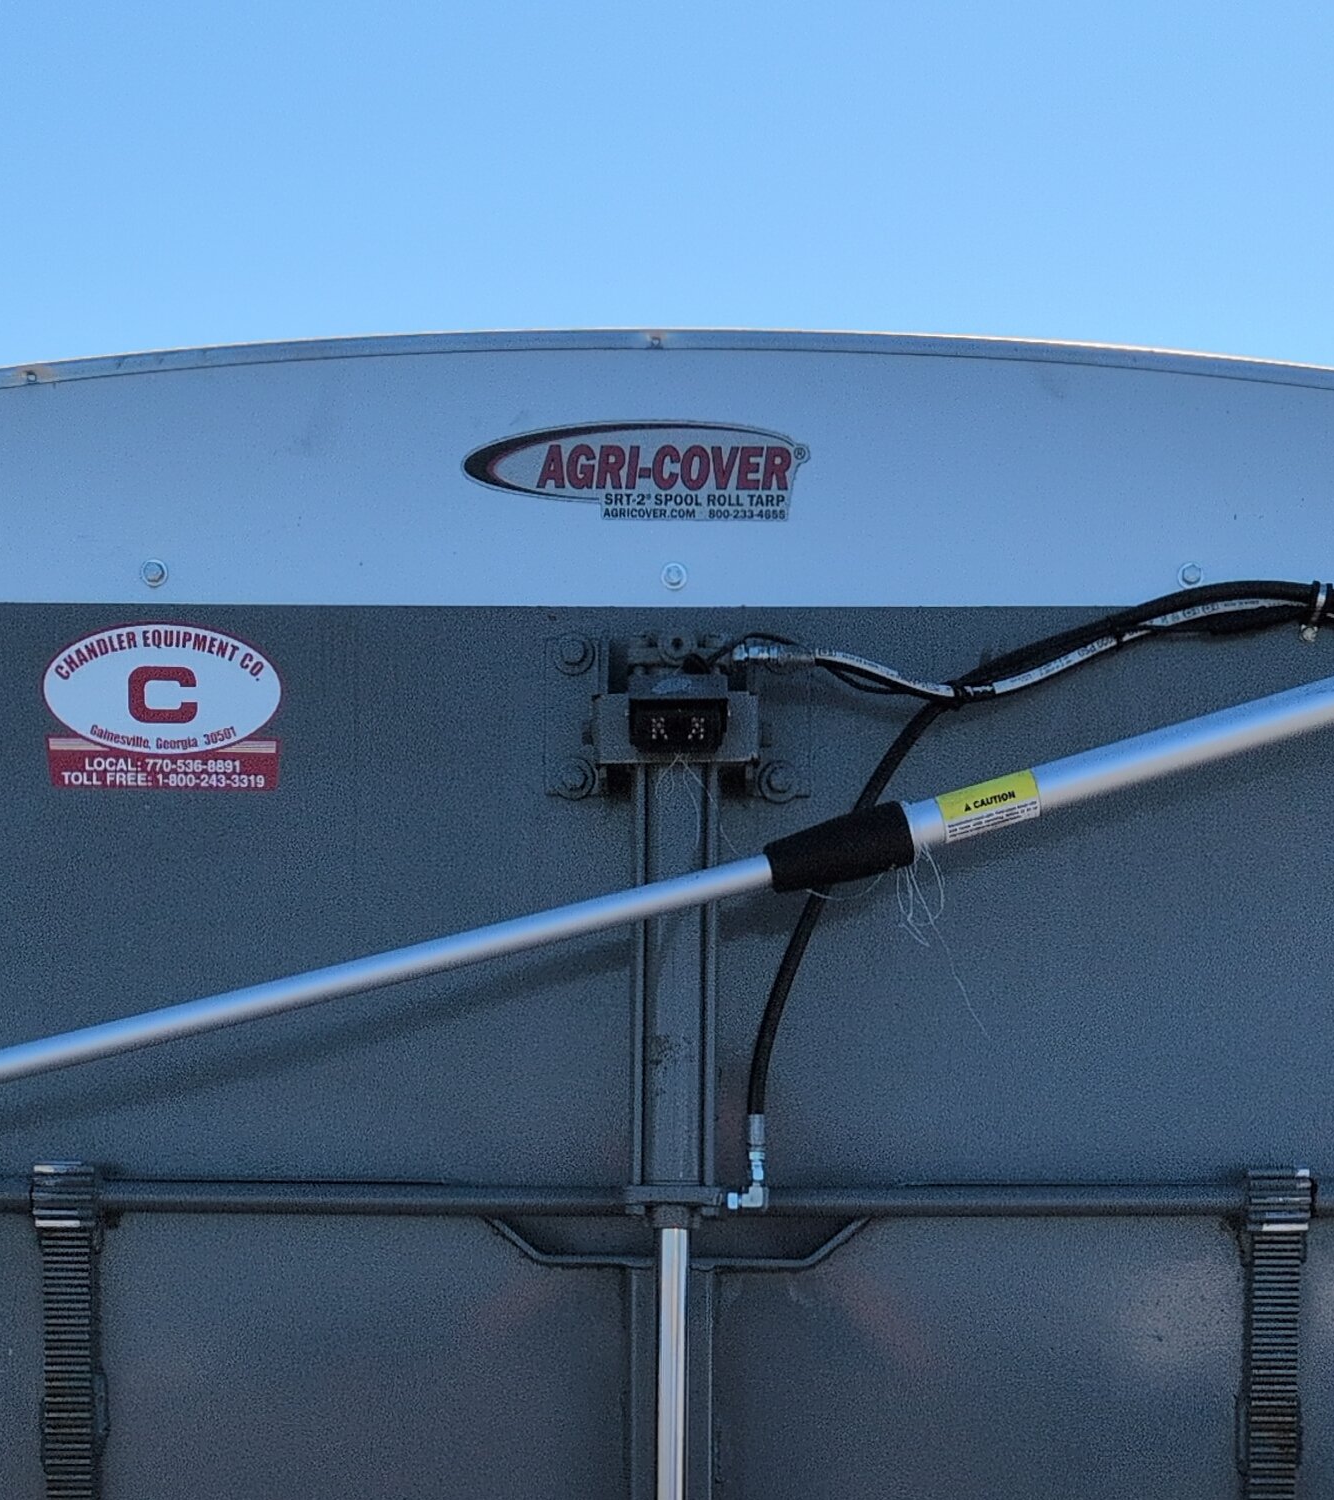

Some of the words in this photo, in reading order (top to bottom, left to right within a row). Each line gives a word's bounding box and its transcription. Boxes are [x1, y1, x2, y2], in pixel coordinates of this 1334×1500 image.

[654, 493, 702, 506] SPOOL
[707, 494, 744, 507] ROLL
[747, 494, 785, 507] TARP
[603, 508, 696, 519] AGRICOVER.COM
[54, 631, 138, 680] CHANDLER
[142, 629, 240, 662] EQUIPMENT
[239, 652, 265, 682] CO.
[128, 666, 198, 724] C
[156, 736, 199, 751] Georgia
[203, 726, 237, 746] 30501
[85, 757, 142, 771] LOCAL:
[145, 759, 241, 773] 770-536-8891
[61, 772, 102, 785] TOLL
[107, 773, 152, 786] FREE:
[156, 773, 265, 787] 1-800-243-3319
[973, 790, 1016, 809] CAUTION
